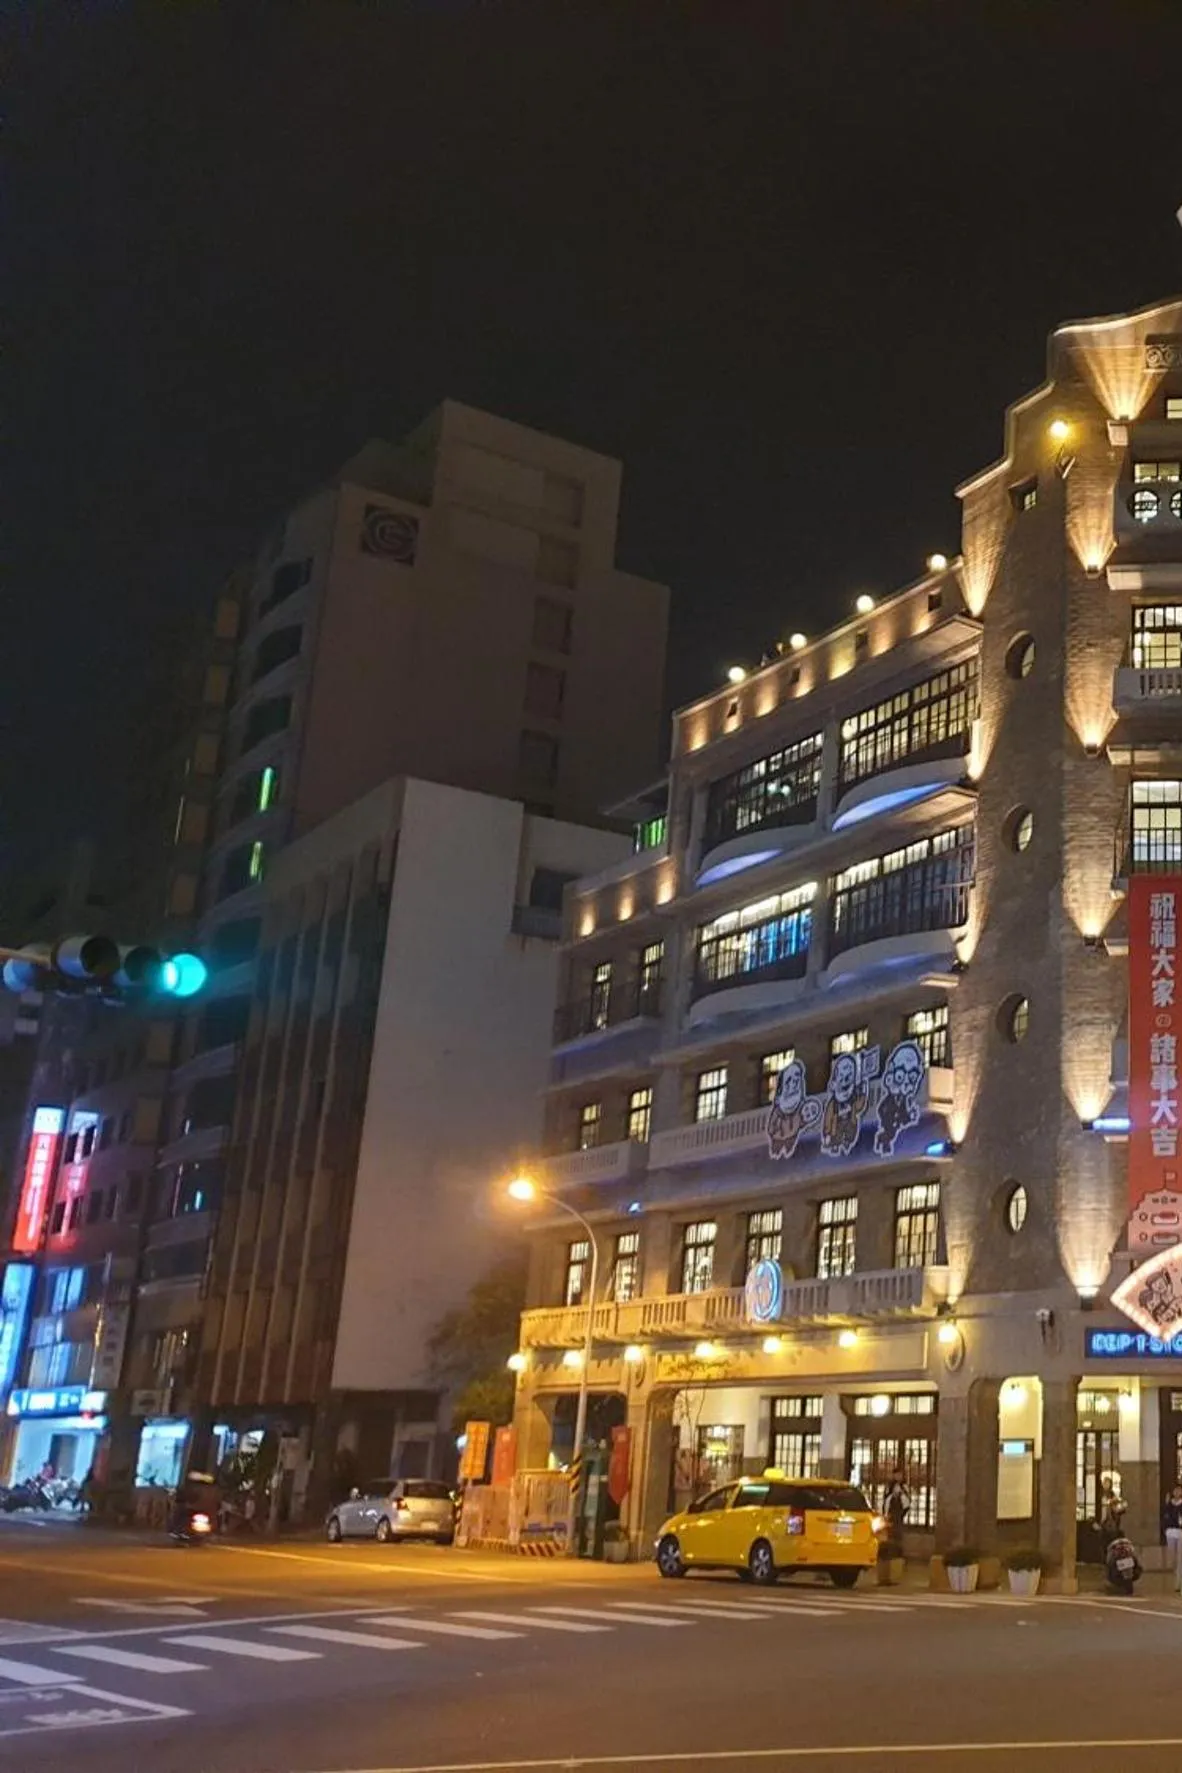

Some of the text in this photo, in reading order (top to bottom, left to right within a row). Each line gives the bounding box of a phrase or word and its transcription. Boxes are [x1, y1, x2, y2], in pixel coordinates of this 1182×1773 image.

[1150, 893, 1178, 1156] 祝福大家 諸事大吉
